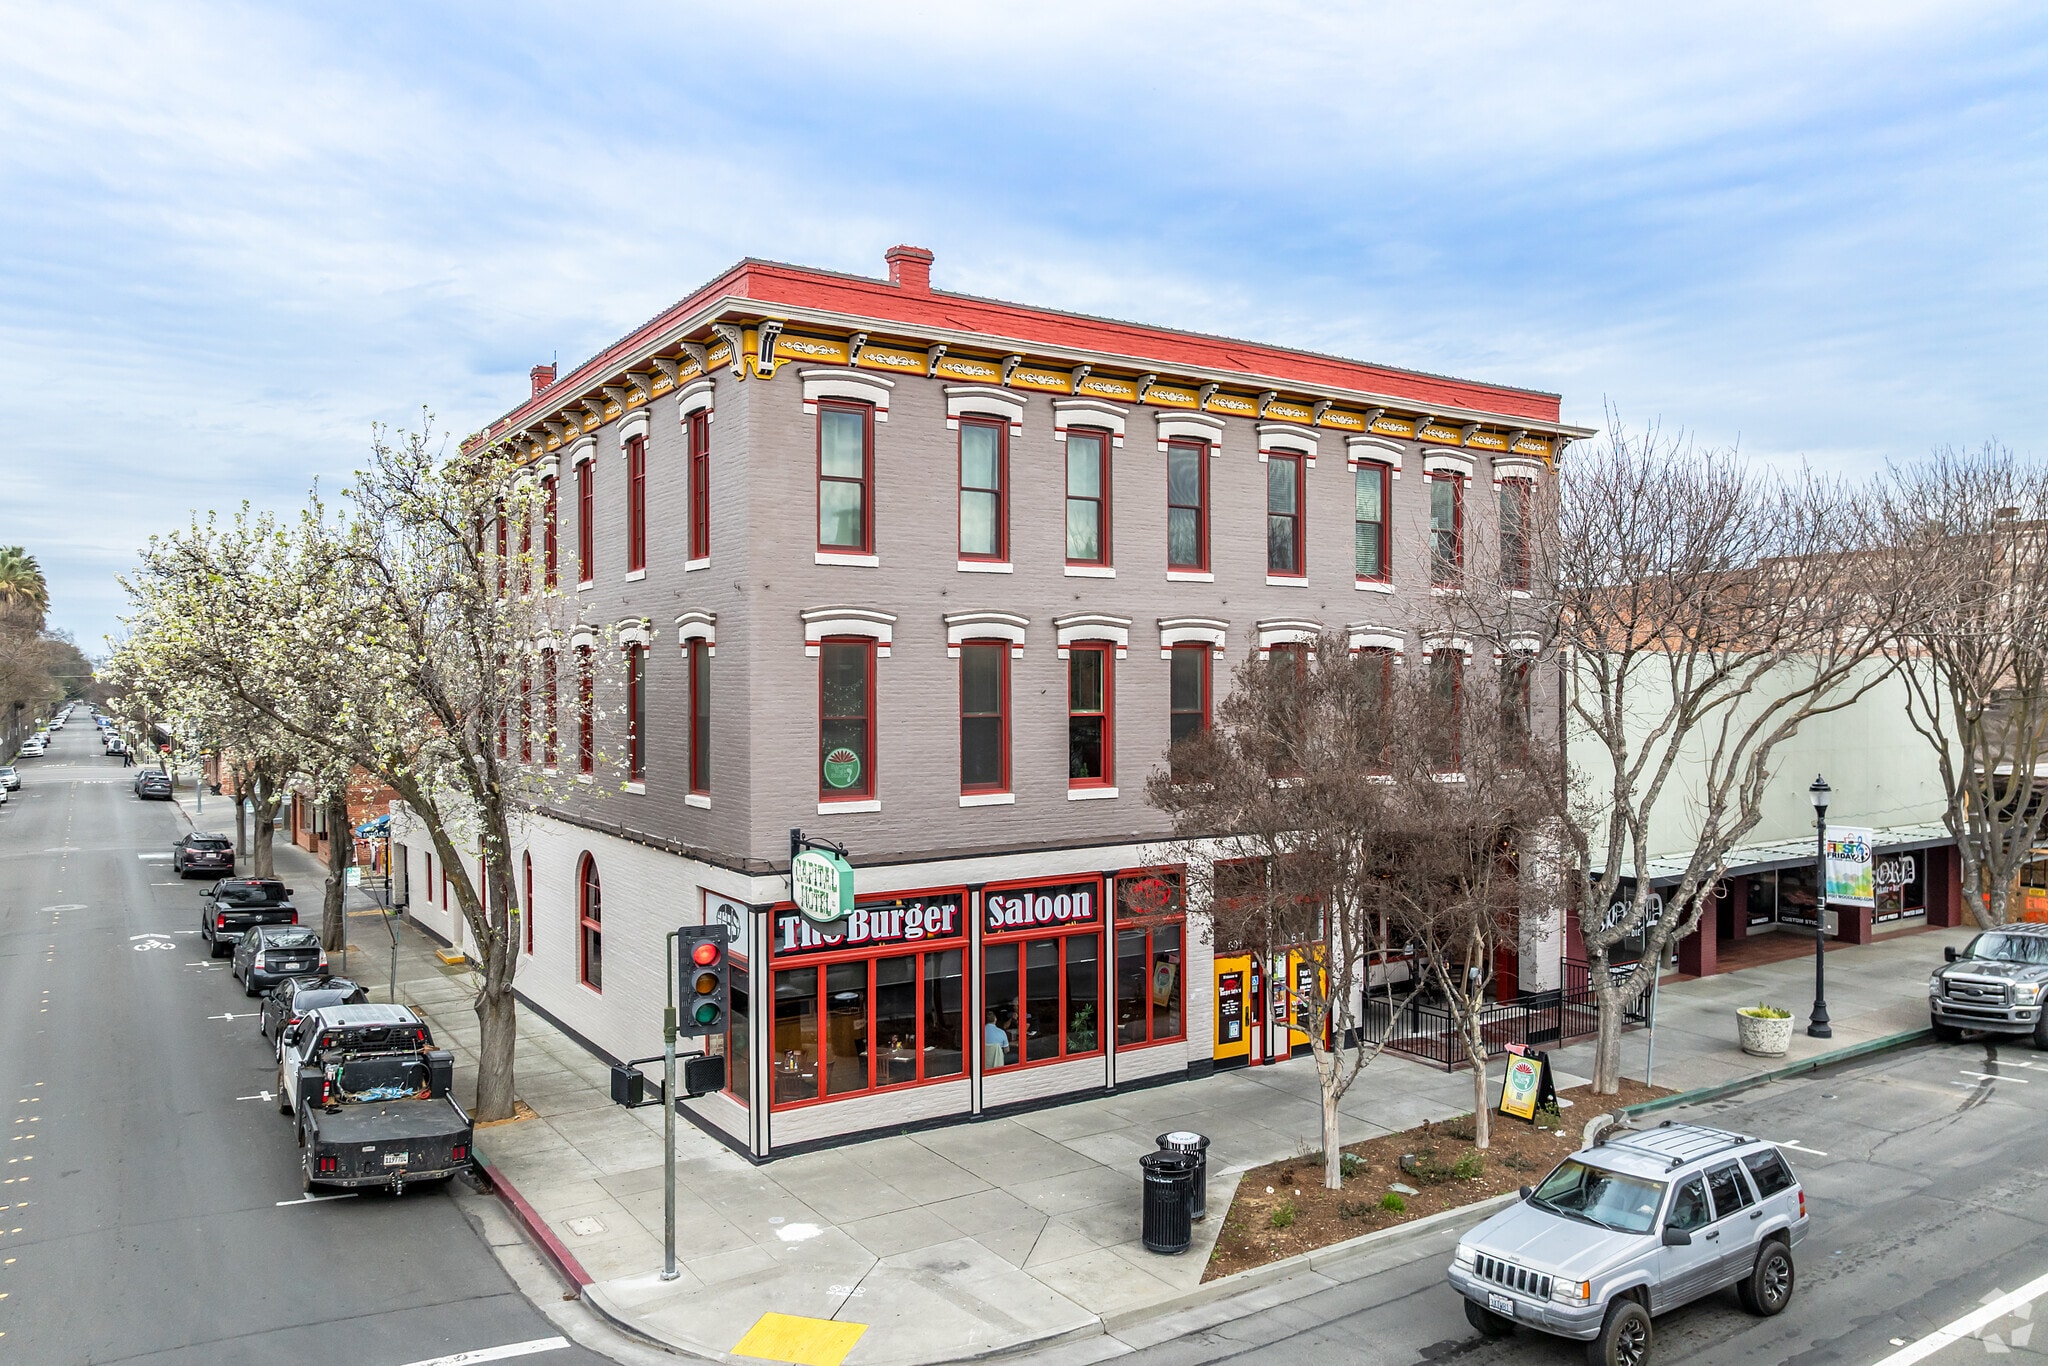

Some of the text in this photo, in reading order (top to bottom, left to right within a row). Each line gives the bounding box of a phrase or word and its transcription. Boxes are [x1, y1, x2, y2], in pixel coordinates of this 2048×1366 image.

[1827, 843, 1856, 853] FIRST
[1827, 852, 1856, 860] FRIDAY
[796, 858, 837, 892] CAPITAL
[801, 885, 831, 916] HOTEL
[847, 903, 958, 944] Burger
[988, 892, 1092, 929] Saloon
[1781, 916, 1804, 924] CUSTOM
